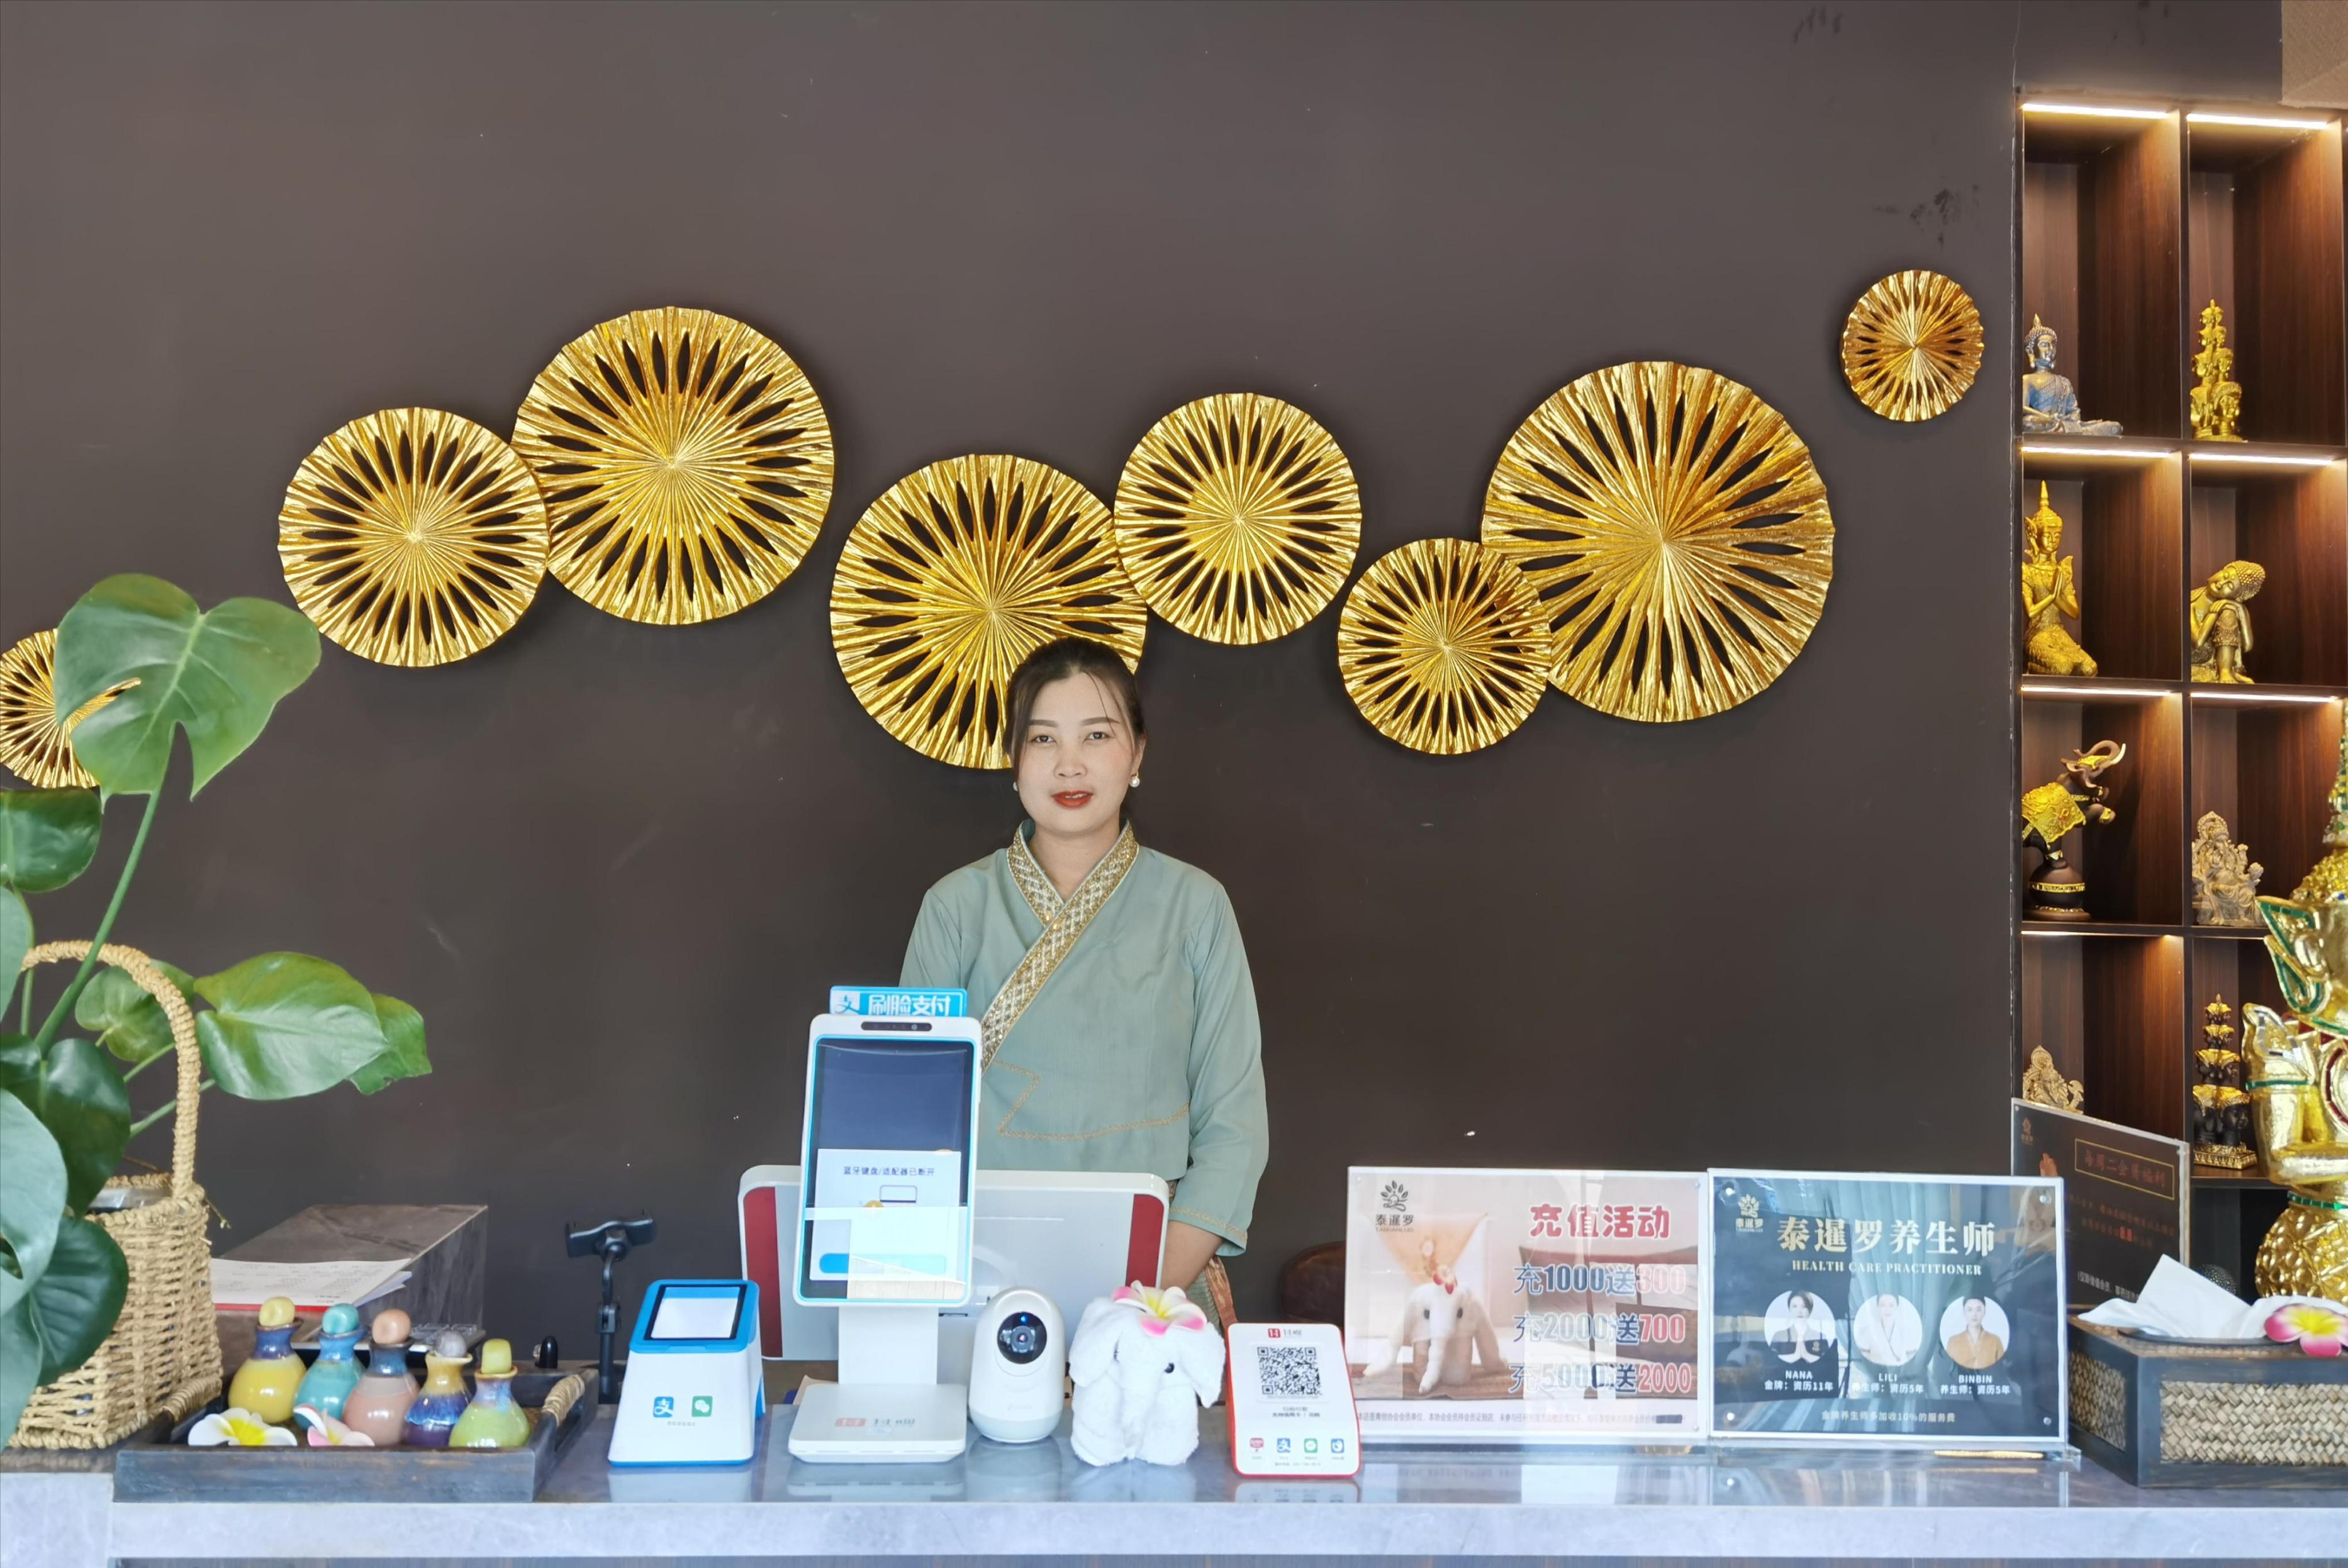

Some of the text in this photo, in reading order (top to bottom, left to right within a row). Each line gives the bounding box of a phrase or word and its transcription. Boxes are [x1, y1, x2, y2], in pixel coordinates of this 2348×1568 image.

[868, 993, 951, 1016] 刷脸支付
[1375, 1214, 1414, 1226] 泰暹罗
[1529, 1204, 1670, 1240] 充值活动
[1777, 1216, 1996, 1257] 泰暹罗养生师
[1513, 1262, 1686, 1295] 充1000送300
[1792, 1260, 1982, 1276] HEALTH CARE PRACTITIONER
[1513, 1311, 1686, 1345] 充2000送700
[1509, 1362, 1692, 1394] 充5000送2000
[1786, 1370, 1813, 1380] NANA
[1879, 1373, 1898, 1382] LILI
[1959, 1374, 1993, 1384] BINBIN
